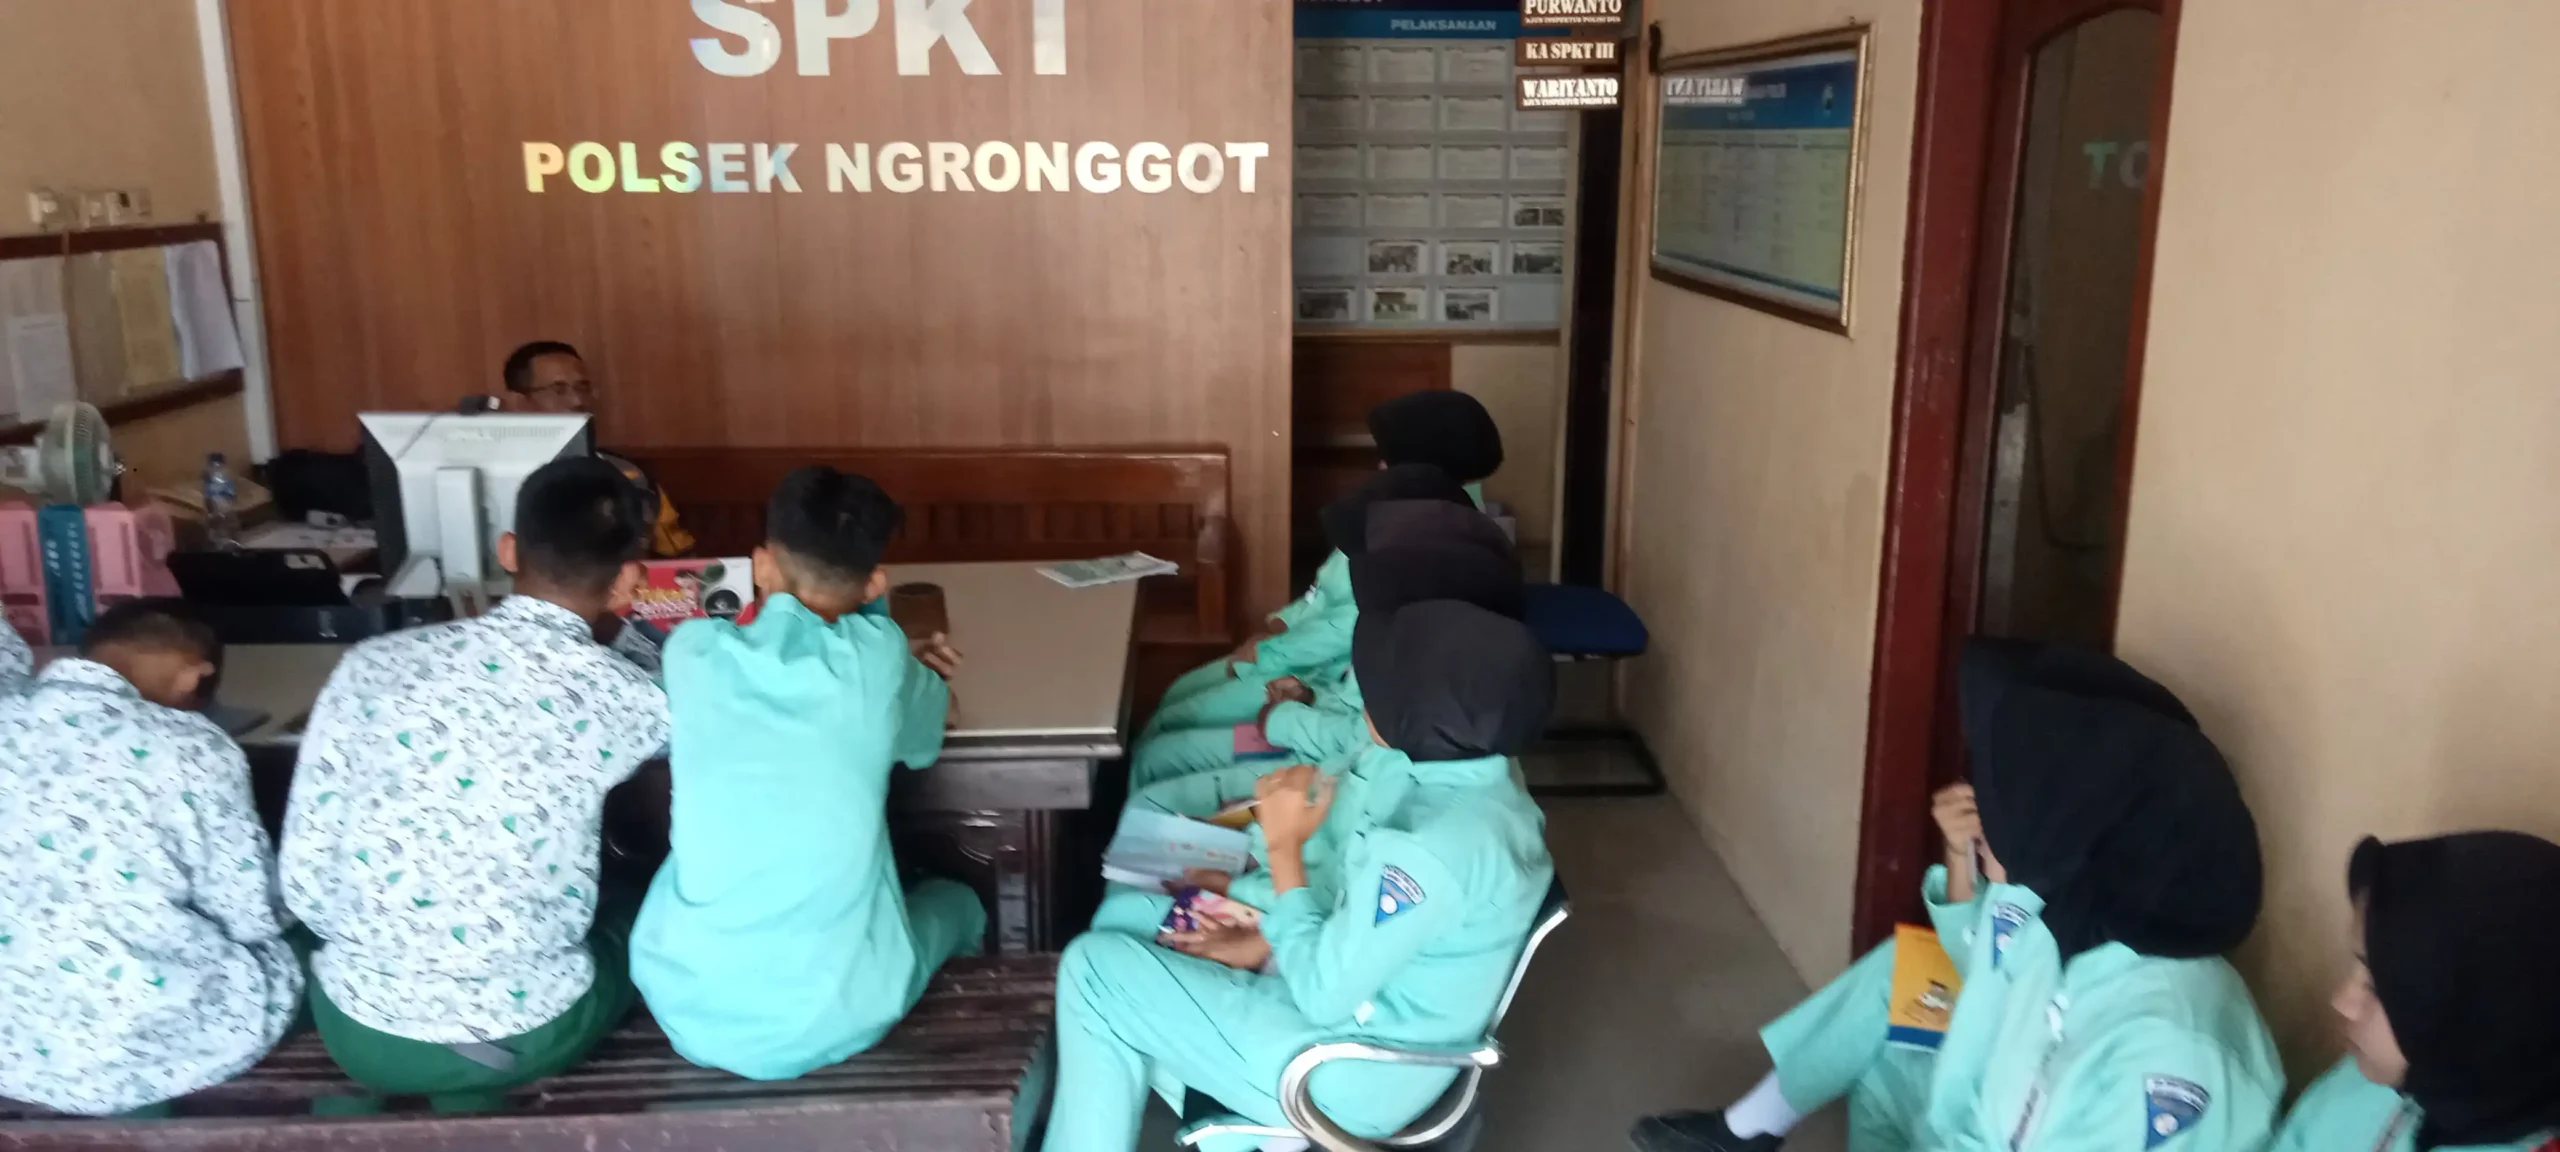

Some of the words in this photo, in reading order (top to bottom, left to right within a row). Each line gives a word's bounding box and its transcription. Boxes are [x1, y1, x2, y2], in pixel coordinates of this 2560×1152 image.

[1391, 19, 1496, 31] PELAKSANAAN
[1525, 42, 1548, 59] KA
[1550, 42, 1594, 59] SPKT
[1595, 42, 1615, 59] III
[1522, 78, 1618, 98] WARIYANTO
[523, 143, 802, 193] POLSEK
[825, 142, 1269, 193] NGRONGGOT
